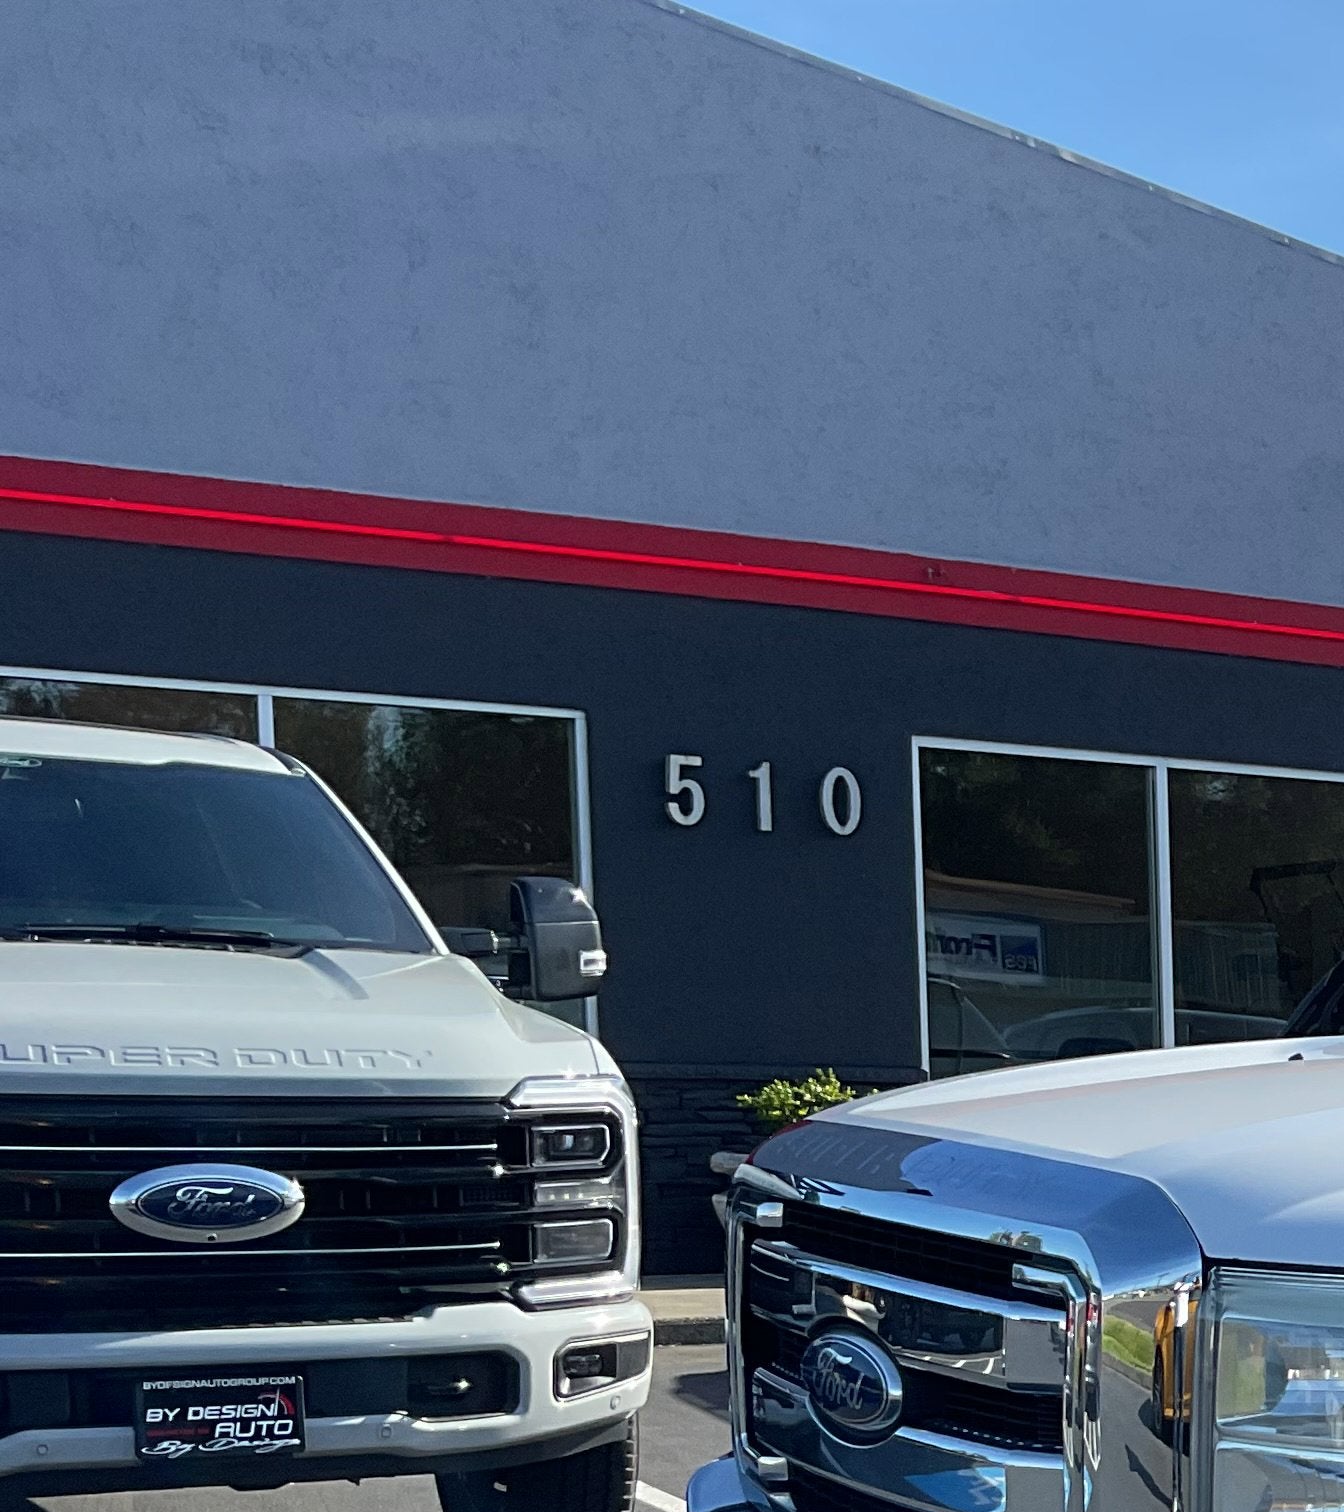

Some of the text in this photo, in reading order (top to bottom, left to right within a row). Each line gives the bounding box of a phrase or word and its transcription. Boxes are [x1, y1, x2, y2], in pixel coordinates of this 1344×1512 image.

[664, 754, 861, 836] 510
[234, 1047, 432, 1070] DUTY
[168, 1186, 256, 1217] Ford
[812, 1347, 864, 1410] Ford
[146, 1403, 275, 1422] BY DESIGN
[215, 1420, 293, 1437] AUTO
[141, 1440, 195, 1458] By
